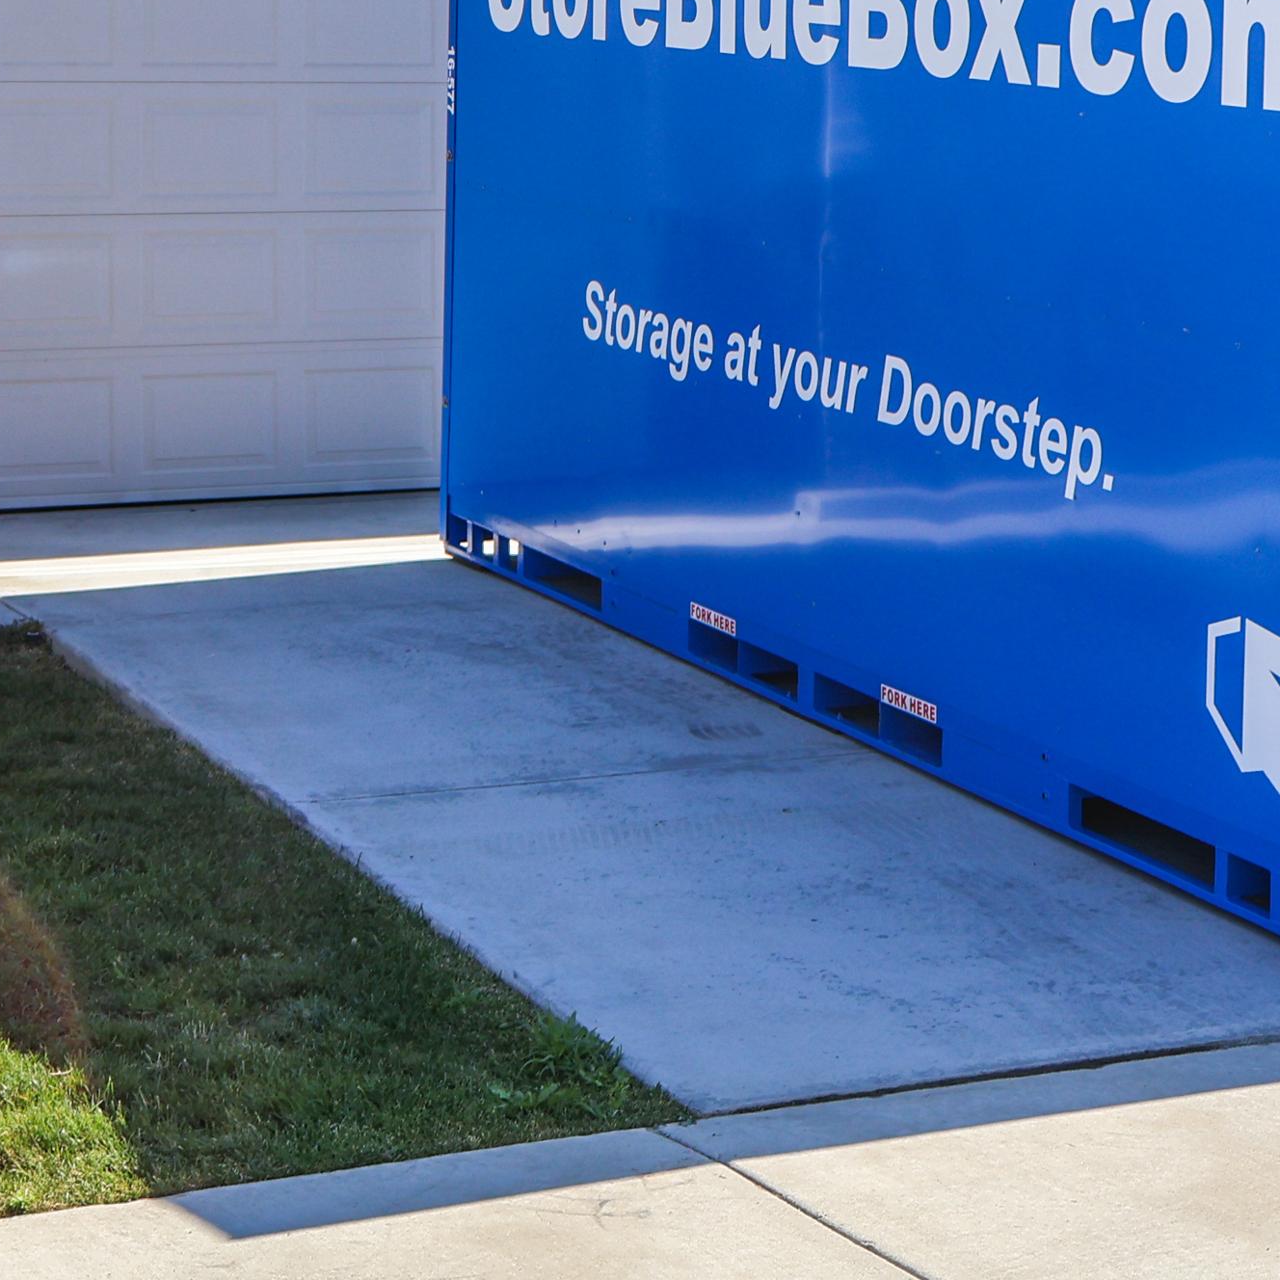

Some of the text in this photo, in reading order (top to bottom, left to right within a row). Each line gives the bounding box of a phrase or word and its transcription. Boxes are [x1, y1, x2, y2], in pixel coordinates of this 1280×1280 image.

[447, 45, 455, 115] 16-577
[582, 280, 1115, 500] Storage at your Doorstep.
[691, 604, 735, 634] FORK HERE
[882, 686, 936, 721] FORK HERE
